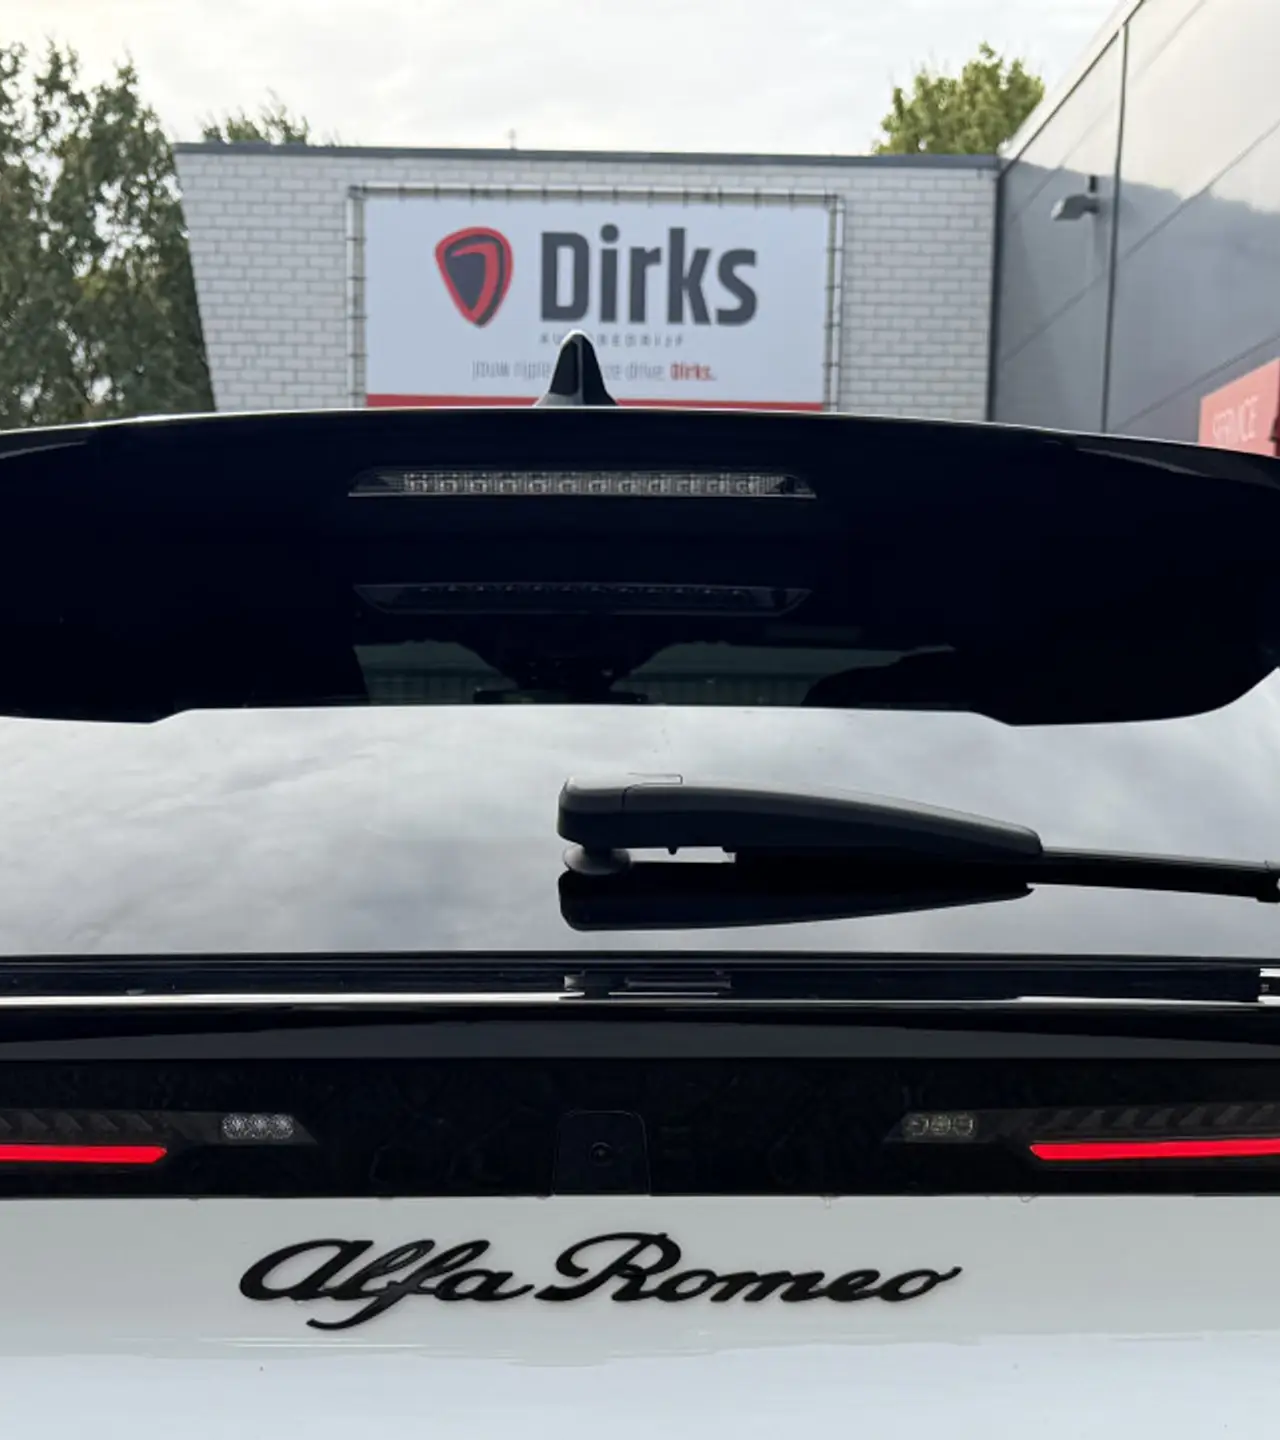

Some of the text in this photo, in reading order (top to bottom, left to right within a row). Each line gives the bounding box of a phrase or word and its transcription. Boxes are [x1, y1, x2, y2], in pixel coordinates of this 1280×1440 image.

[540, 223, 758, 327] Dirks
[540, 332, 684, 348] AUBEDRIJF
[239, 1232, 962, 1331] Alfa Romeo
